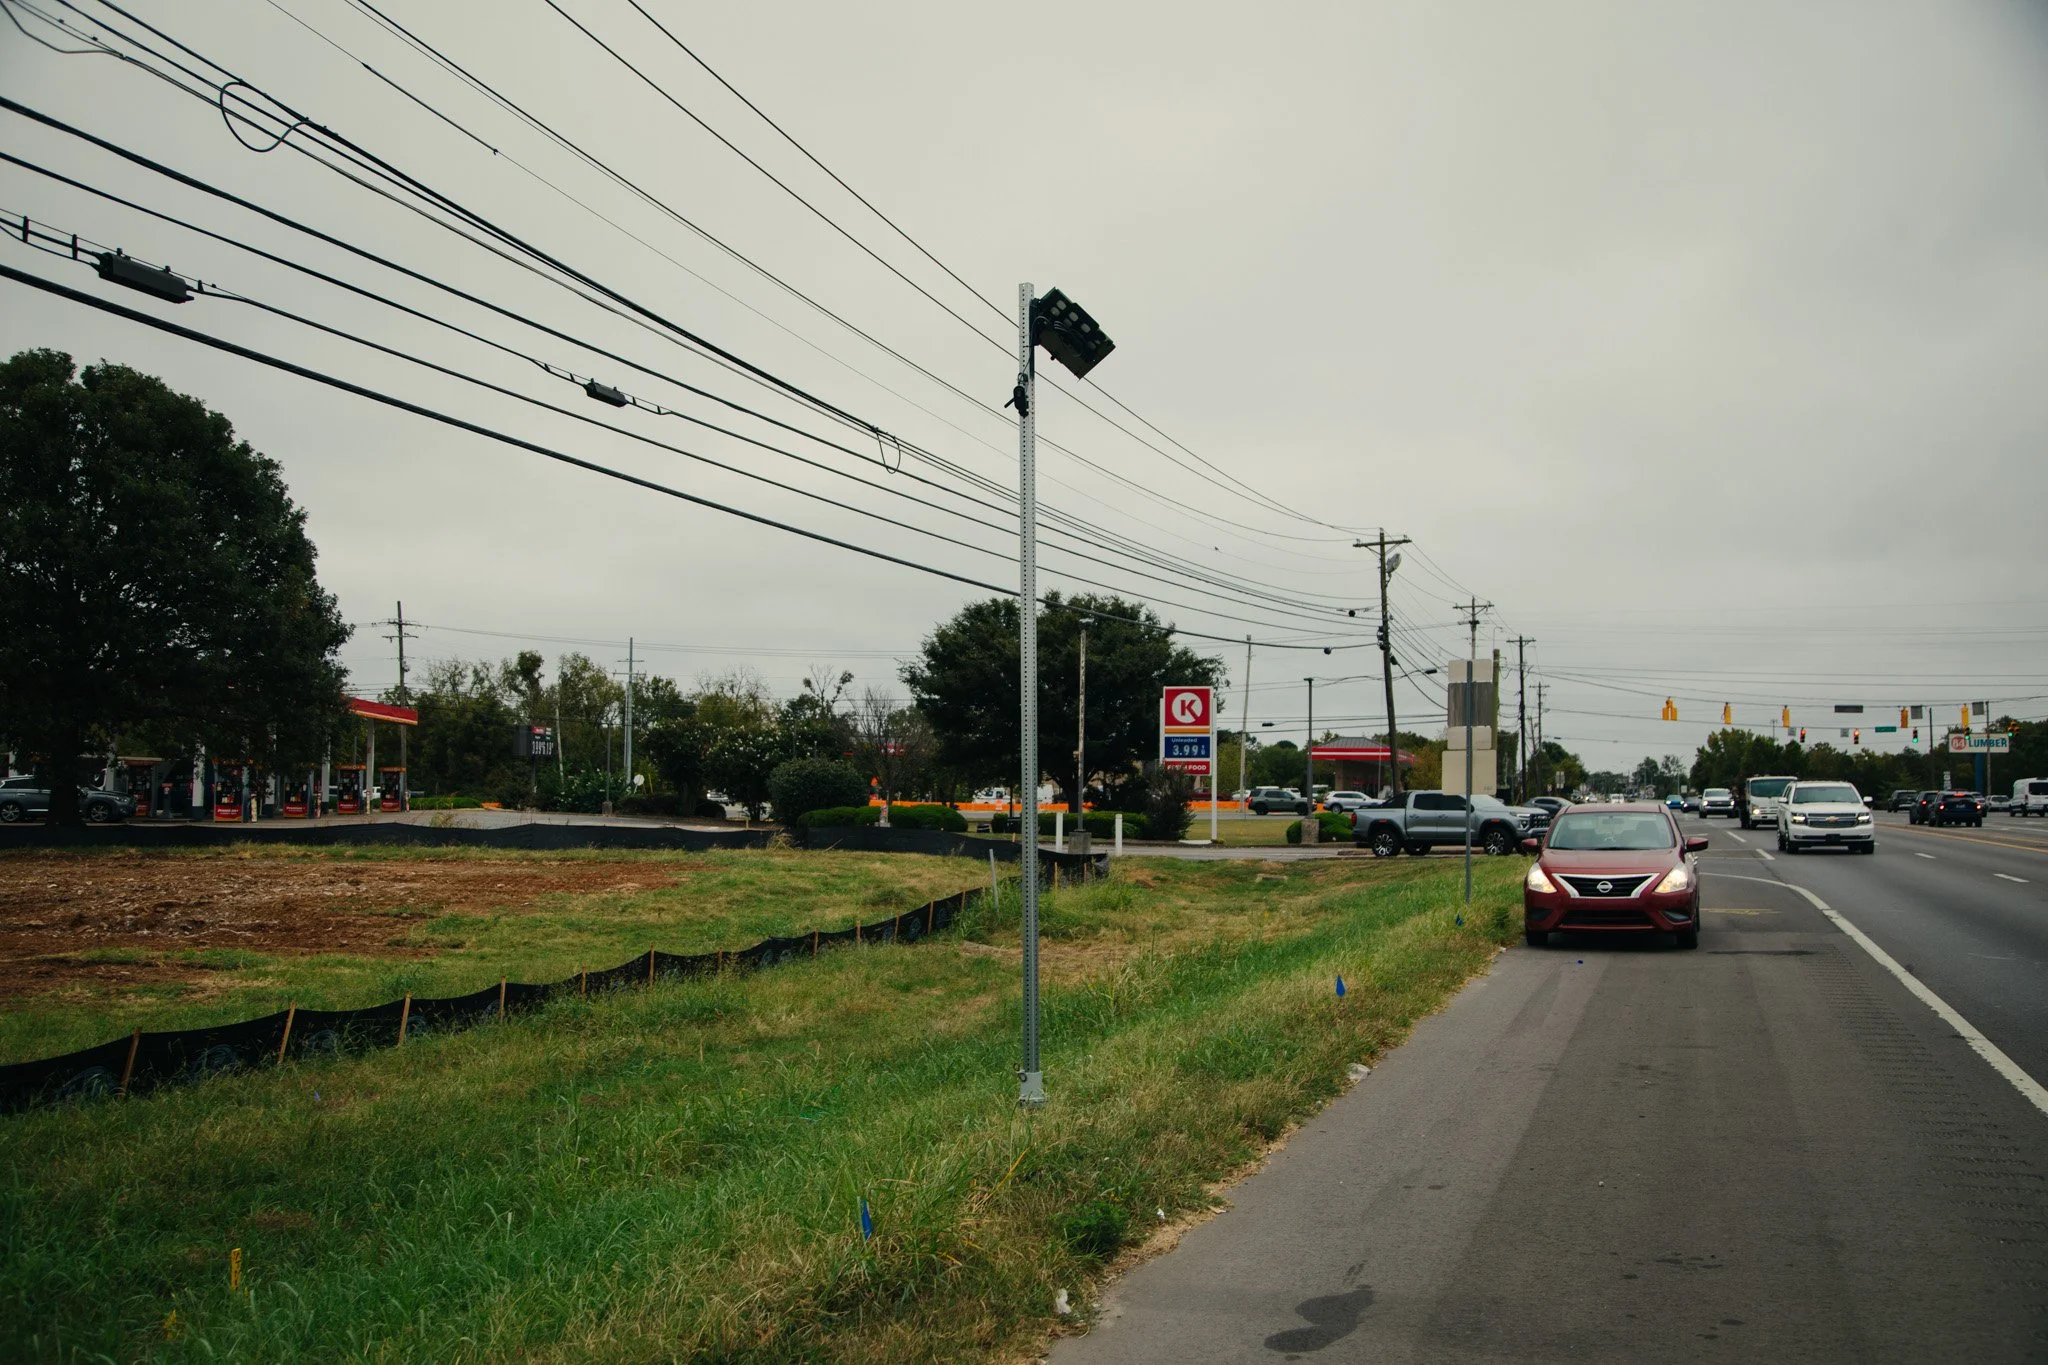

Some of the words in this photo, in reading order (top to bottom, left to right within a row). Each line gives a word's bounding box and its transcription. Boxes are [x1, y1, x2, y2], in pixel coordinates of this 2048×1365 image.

[1180, 699, 1200, 720] K
[1968, 738, 2007, 747] LUMBER
[1172, 744, 1199, 756] 3.99
